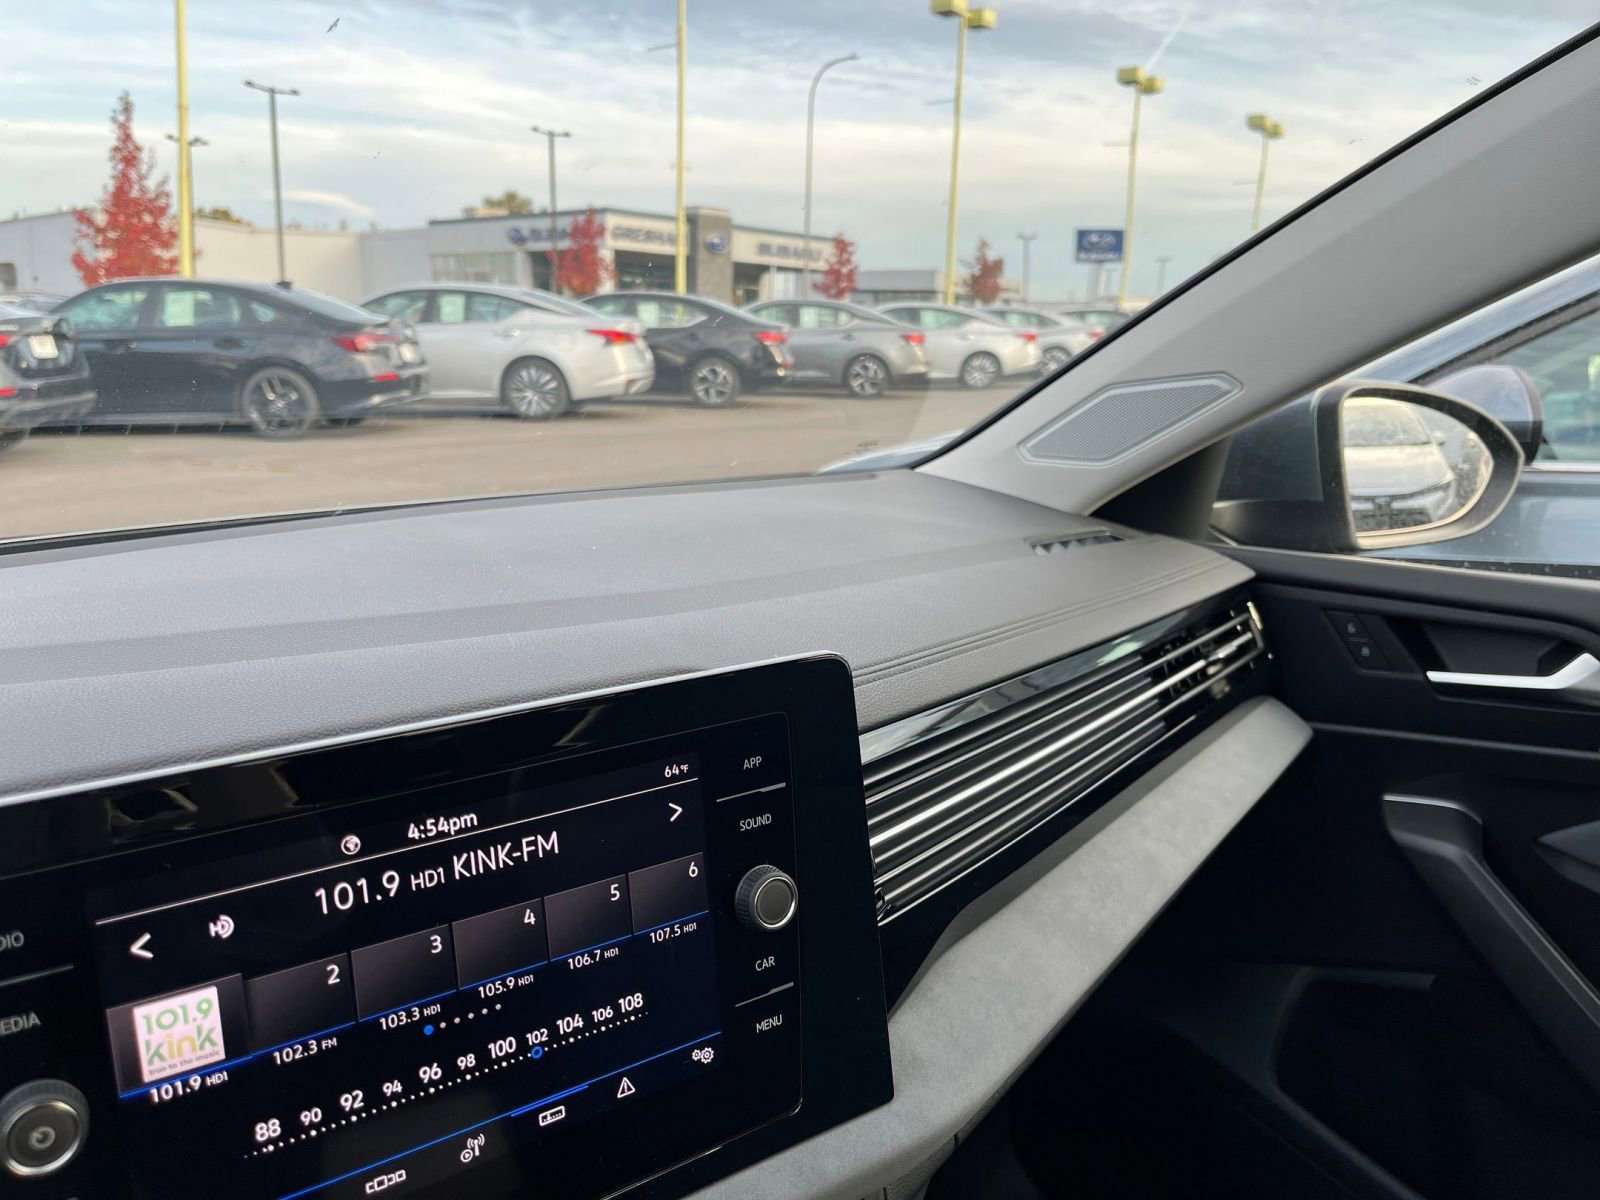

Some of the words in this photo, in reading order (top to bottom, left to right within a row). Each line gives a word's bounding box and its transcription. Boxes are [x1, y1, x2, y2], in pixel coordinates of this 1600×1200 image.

[743, 755, 762, 770] APP
[408, 812, 478, 841] 4:54pm
[739, 813, 772, 831] SOUND
[315, 870, 400, 915] 101.9
[410, 867, 445, 892] HD1
[453, 831, 559, 880] KINK-FM
[688, 861, 699, 878] 6
[610, 884, 621, 901] 5
[523, 908, 536, 925] 4
[649, 925, 681, 943] 107.5
[683, 922, 697, 934] HD1
[430, 935, 443, 954] 3
[567, 950, 600, 970] 106.7
[603, 947, 619, 959] HD1
[755, 956, 776, 972] CAR
[326, 964, 341, 985] 2
[478, 977, 515, 998] 105.9
[517, 974, 534, 987] HD1
[0, 1011, 41, 1036] EDIA
[143, 998, 213, 1035] 101.9
[380, 1007, 420, 1030] 103.3
[423, 1003, 441, 1017] HD1
[755, 1014, 783, 1033] MENU
[145, 1025, 217, 1065] kink
[273, 1040, 318, 1065] 102.3
[321, 1037, 338, 1050] FM
[254, 1118, 281, 1142] 88
[300, 1107, 323, 1126] 90
[340, 1090, 365, 1111] 92
[382, 1079, 403, 1097] 94
[418, 1063, 443, 1084] 96
[456, 1053, 476, 1070] 98
[487, 1037, 517, 1059] 100
[525, 1027, 548, 1046] 102
[556, 1013, 584, 1035] 104
[591, 1005, 614, 1023] 106
[617, 992, 644, 1012] 108
[150, 1075, 202, 1103] 101.9
[205, 1071, 229, 1087] HD1
